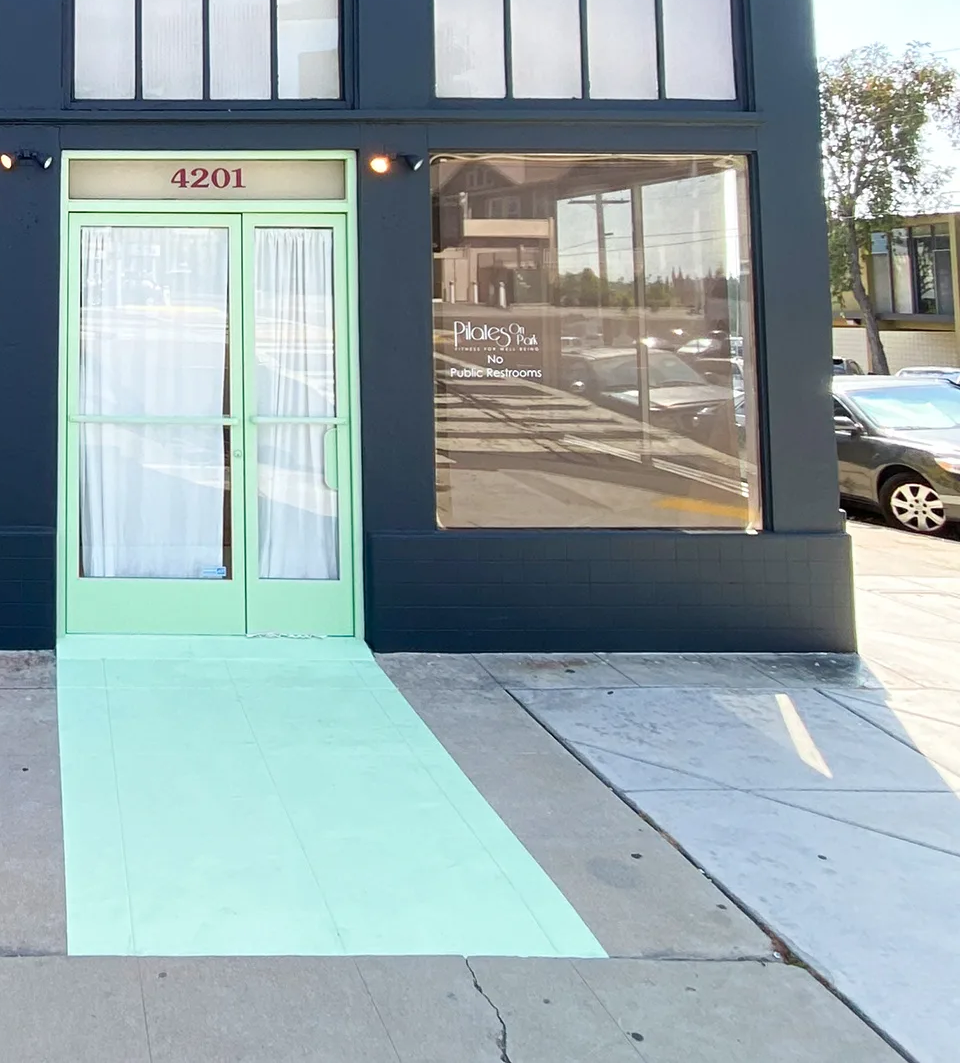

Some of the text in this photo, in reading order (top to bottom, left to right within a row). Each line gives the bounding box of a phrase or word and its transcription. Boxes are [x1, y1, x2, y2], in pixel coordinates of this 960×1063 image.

[171, 168, 246, 188] 4201
[454, 321, 525, 347] Pilates On
[516, 334, 539, 346] Park
[487, 355, 504, 364] No
[450, 368, 542, 378] Public Restrooms
